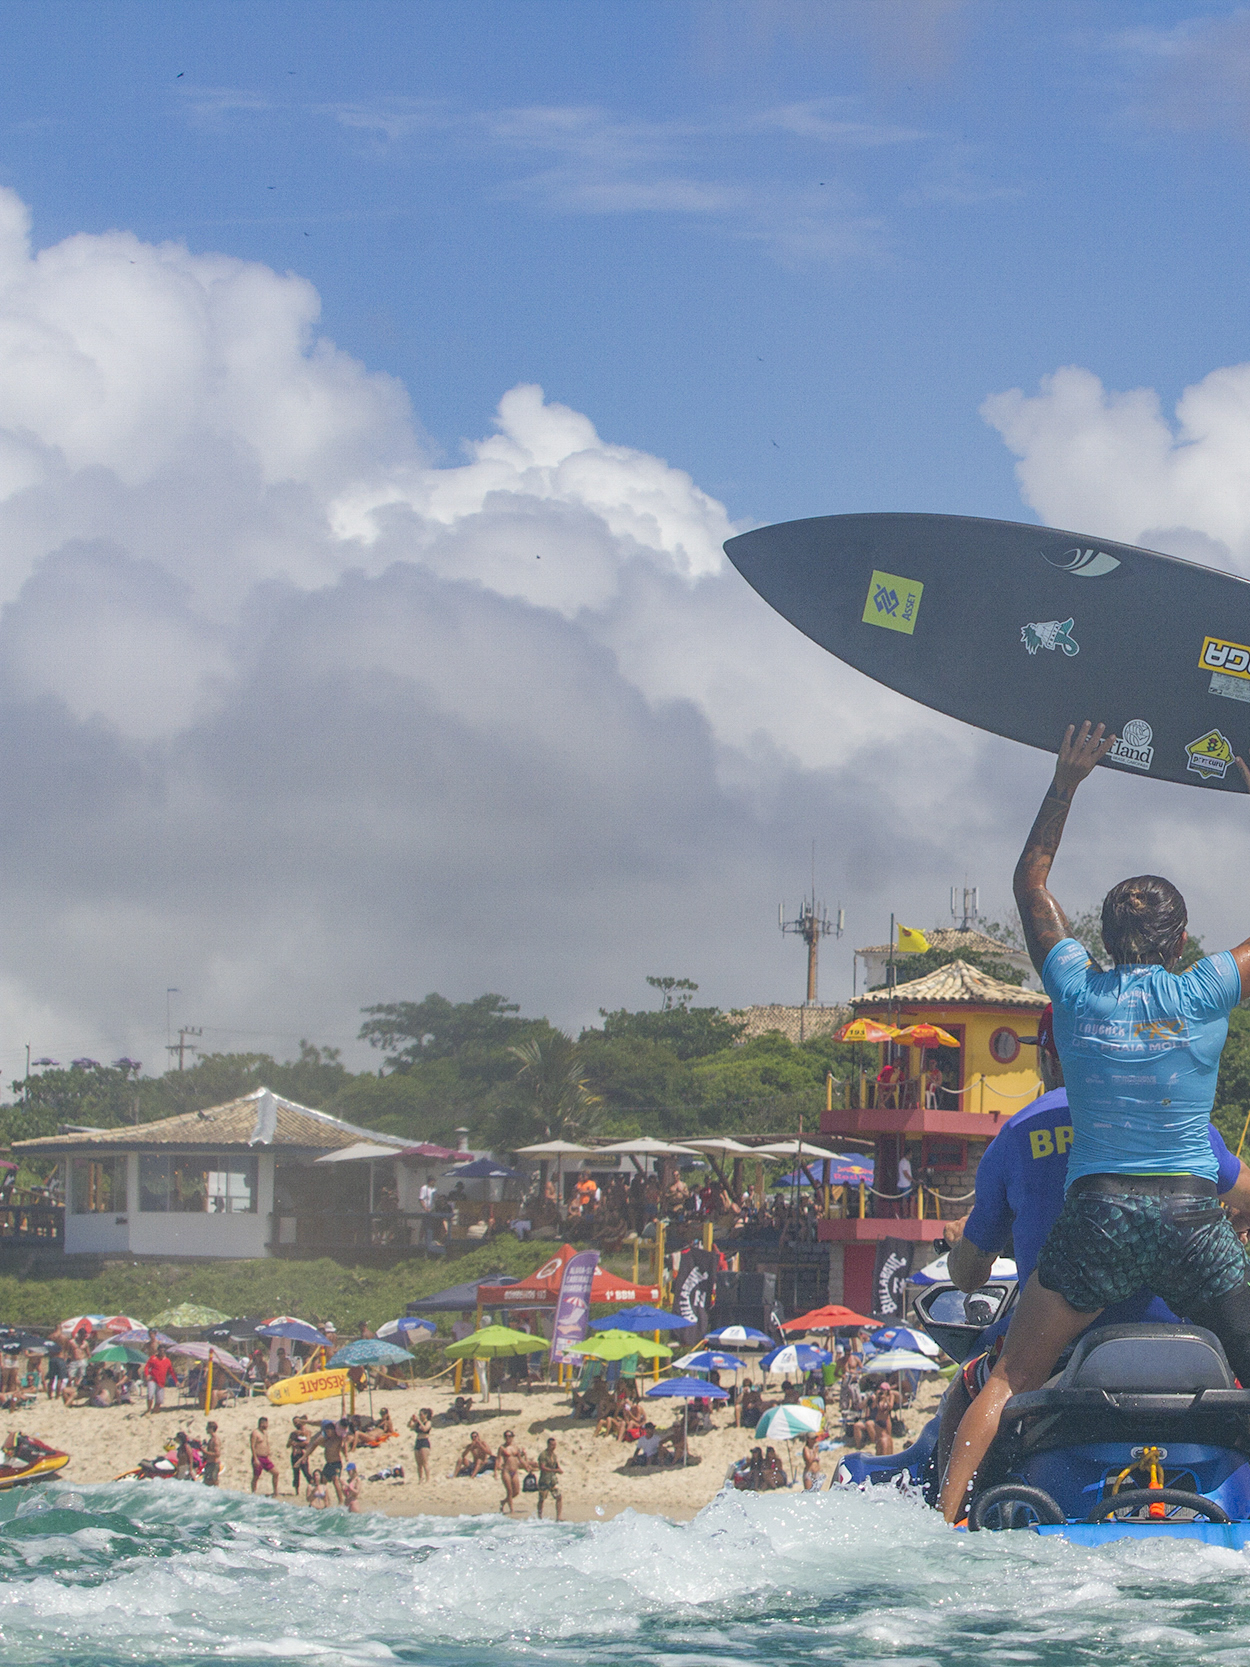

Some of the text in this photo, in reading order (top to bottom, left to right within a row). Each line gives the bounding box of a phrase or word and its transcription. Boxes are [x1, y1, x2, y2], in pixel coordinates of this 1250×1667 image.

[901, 592, 916, 622] ASSET
[1079, 1020, 1184, 1040] LAYBACK PRO
[1102, 1041, 1145, 1052] PRAIA
[1150, 1039, 1190, 1051] MOLE
[679, 1266, 709, 1323] BILLABONG
[878, 1252, 907, 1315] BILLABONG
[299, 1374, 345, 1394] RESGATE
